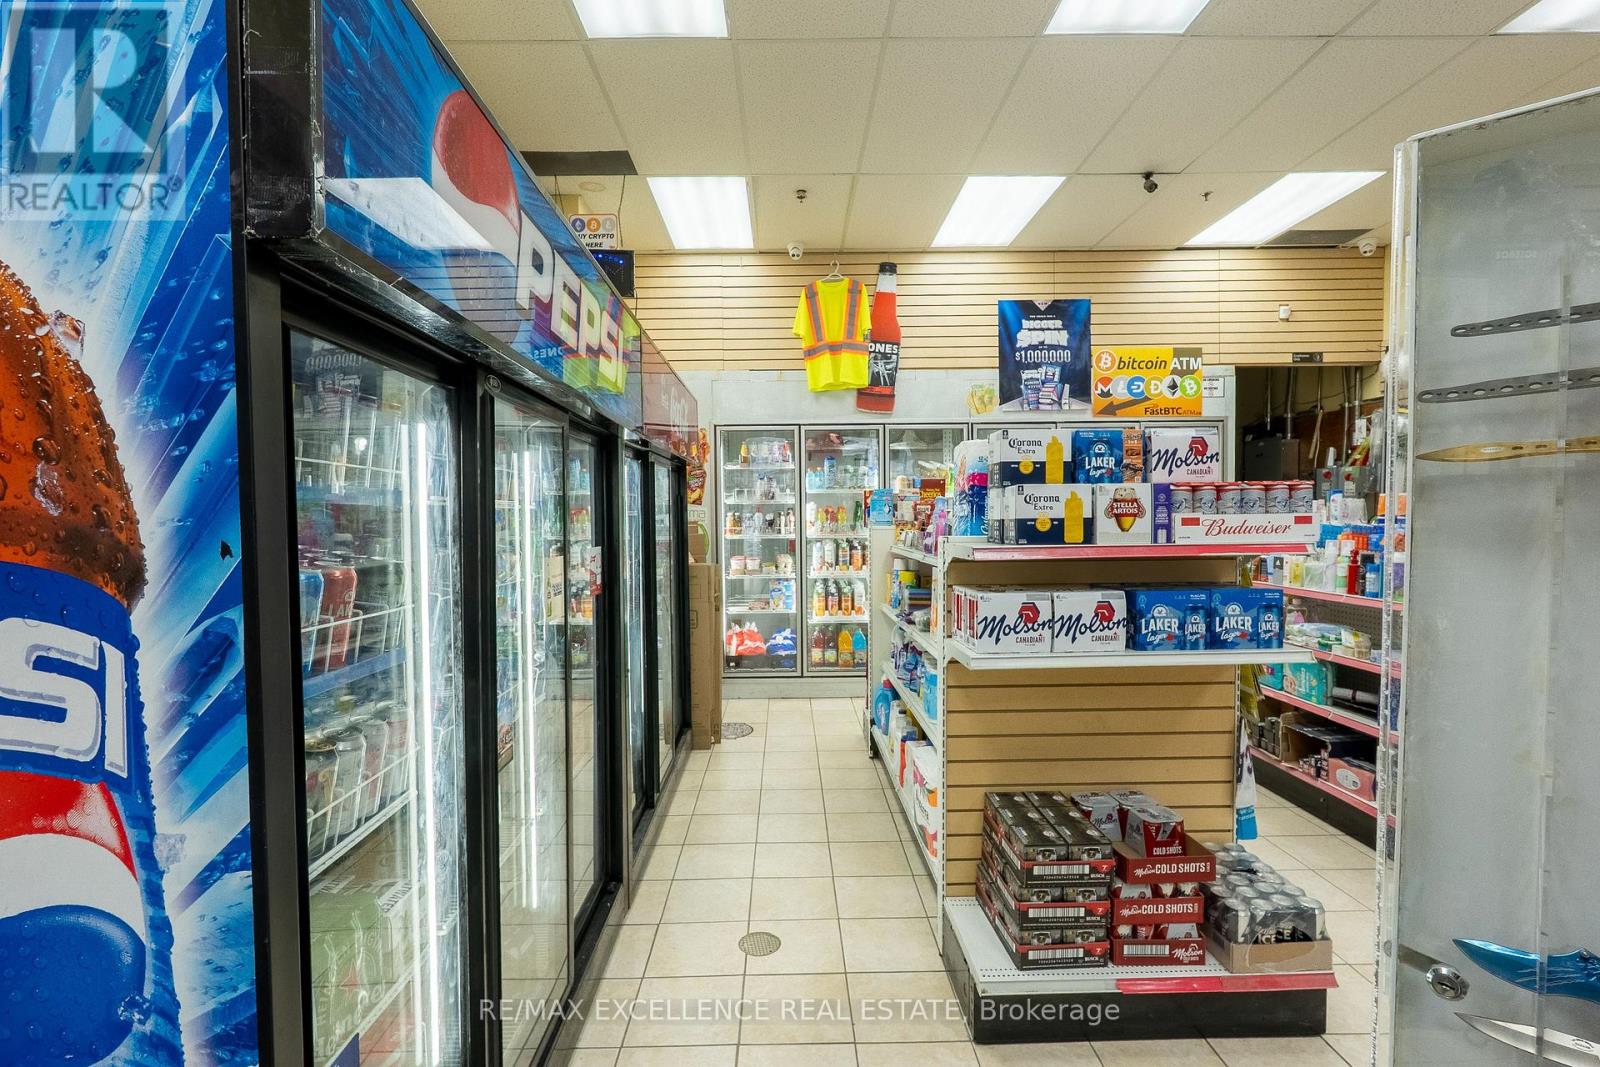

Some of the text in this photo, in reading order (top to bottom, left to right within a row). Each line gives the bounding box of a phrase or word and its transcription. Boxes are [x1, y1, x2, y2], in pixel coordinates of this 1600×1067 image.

[516, 210, 625, 392] PEPSI
[1016, 329, 1069, 348] SPIN
[868, 342, 899, 354] ONES
[1015, 349, 1071, 364] $1,000,000
[1117, 356, 1202, 370] bitcoin ATM
[1008, 437, 1043, 448] Corona
[1085, 456, 1115, 470] LAKER
[1152, 446, 1220, 477] Molson
[1186, 468, 1213, 476] CANADIAN
[1023, 492, 1060, 505] Corona
[1202, 518, 1291, 537] Budweiser
[977, 613, 1053, 645] Molson
[1055, 612, 1128, 645] Molson
[1141, 618, 1179, 634] LAKER
[1185, 623, 1206, 635] LAKER
[1215, 616, 1252, 633] LAKER
[1258, 621, 1280, 633] LAKER
[1015, 635, 1046, 644] CANADIAN
[1091, 634, 1120, 642] CANADIAN
[1153, 845, 1182, 855] COLD SHOTS
[1133, 864, 1155, 877] Molson
[1155, 864, 1177, 874] COLD
[1178, 862, 1206, 873] SHOTS
[1120, 905, 1142, 917] Molson
[1142, 904, 1164, 914] COLD
[1165, 903, 1193, 913] SHOTS
[1171, 946, 1203, 960] Molson
